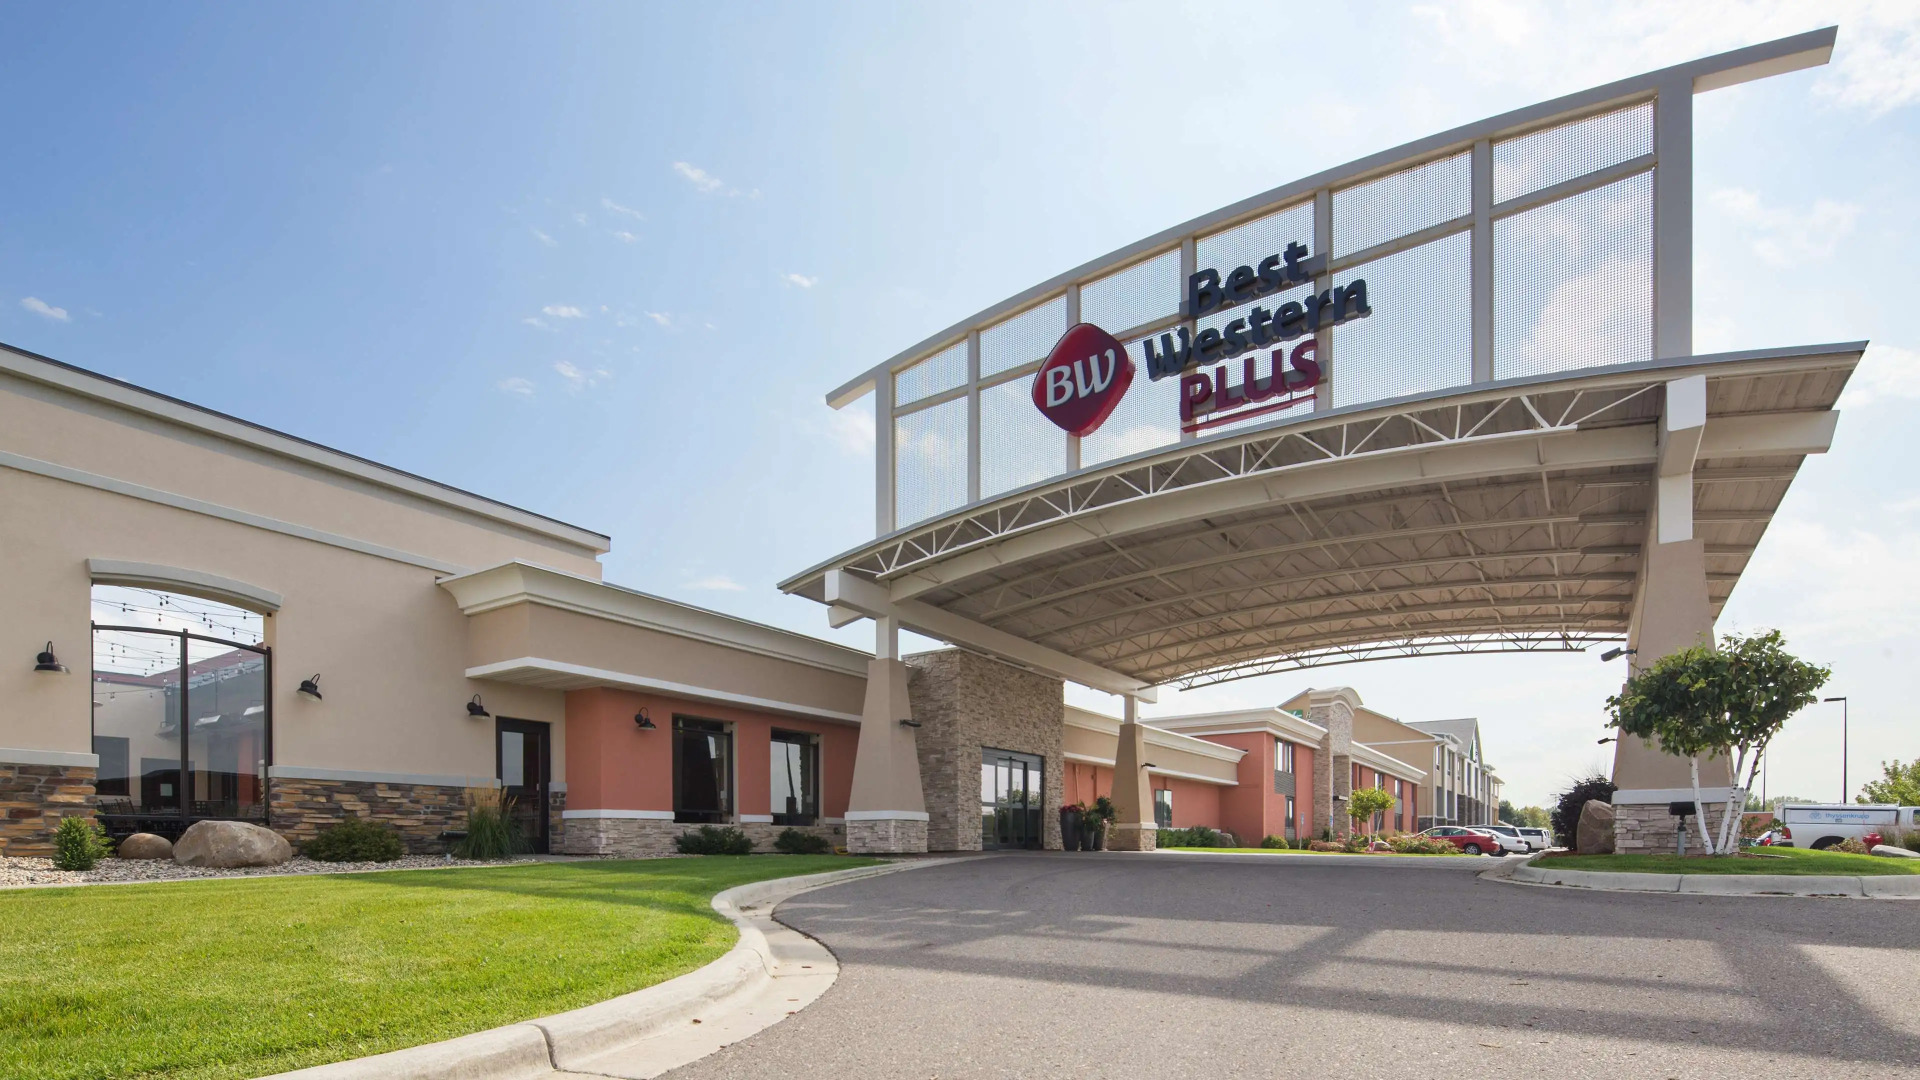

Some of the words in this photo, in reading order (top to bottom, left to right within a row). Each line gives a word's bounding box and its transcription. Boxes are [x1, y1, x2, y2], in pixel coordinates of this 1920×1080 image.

[1188, 241, 1310, 319] Best
[1143, 278, 1372, 382] Western
[1045, 348, 1117, 408] BW
[1180, 339, 1322, 422] PLUS
